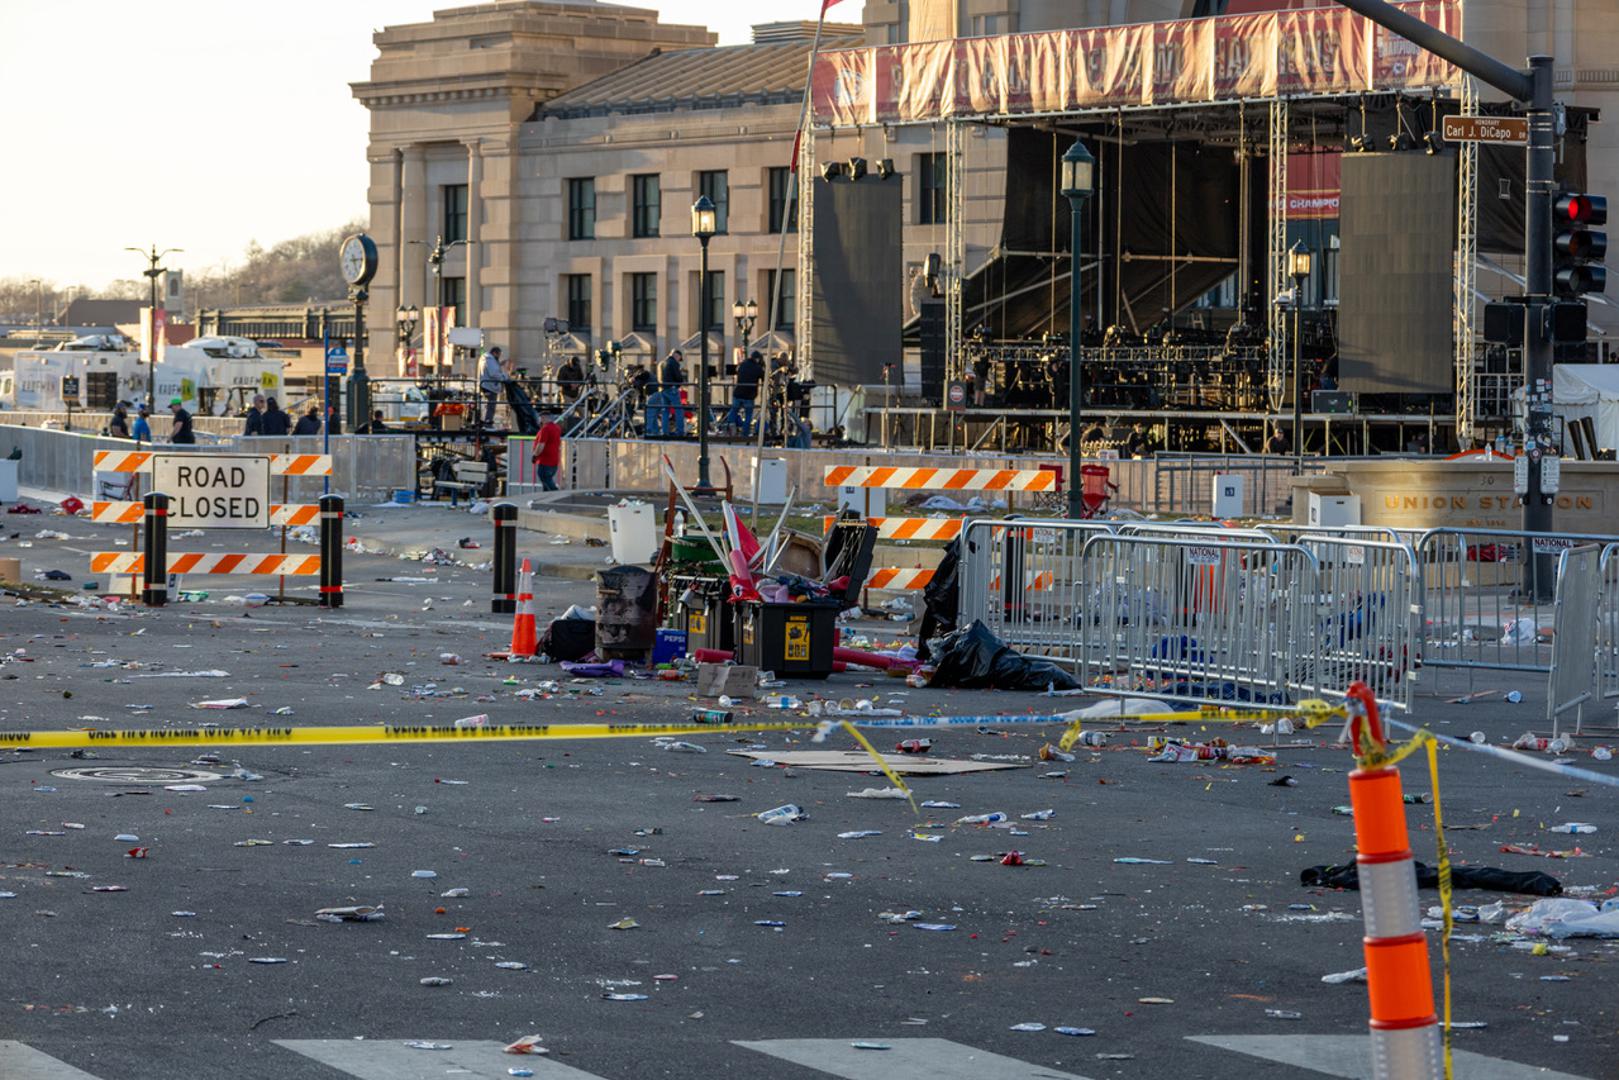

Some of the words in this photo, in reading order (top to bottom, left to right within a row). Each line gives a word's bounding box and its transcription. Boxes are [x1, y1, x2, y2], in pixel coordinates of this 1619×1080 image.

[1446, 125, 1464, 137] Carl
[1468, 126, 1476, 137] J.
[1480, 126, 1511, 139] DiCapo
[1290, 198, 1340, 209] CHAMPIO
[178, 466, 246, 488] ROAD
[167, 497, 259, 519] CLOSED
[1384, 495, 1468, 510] UNION
[1479, 495, 1592, 511] STAON
[1534, 538, 1571, 548] NATIONAL
[664, 635, 686, 643] PEPSI
